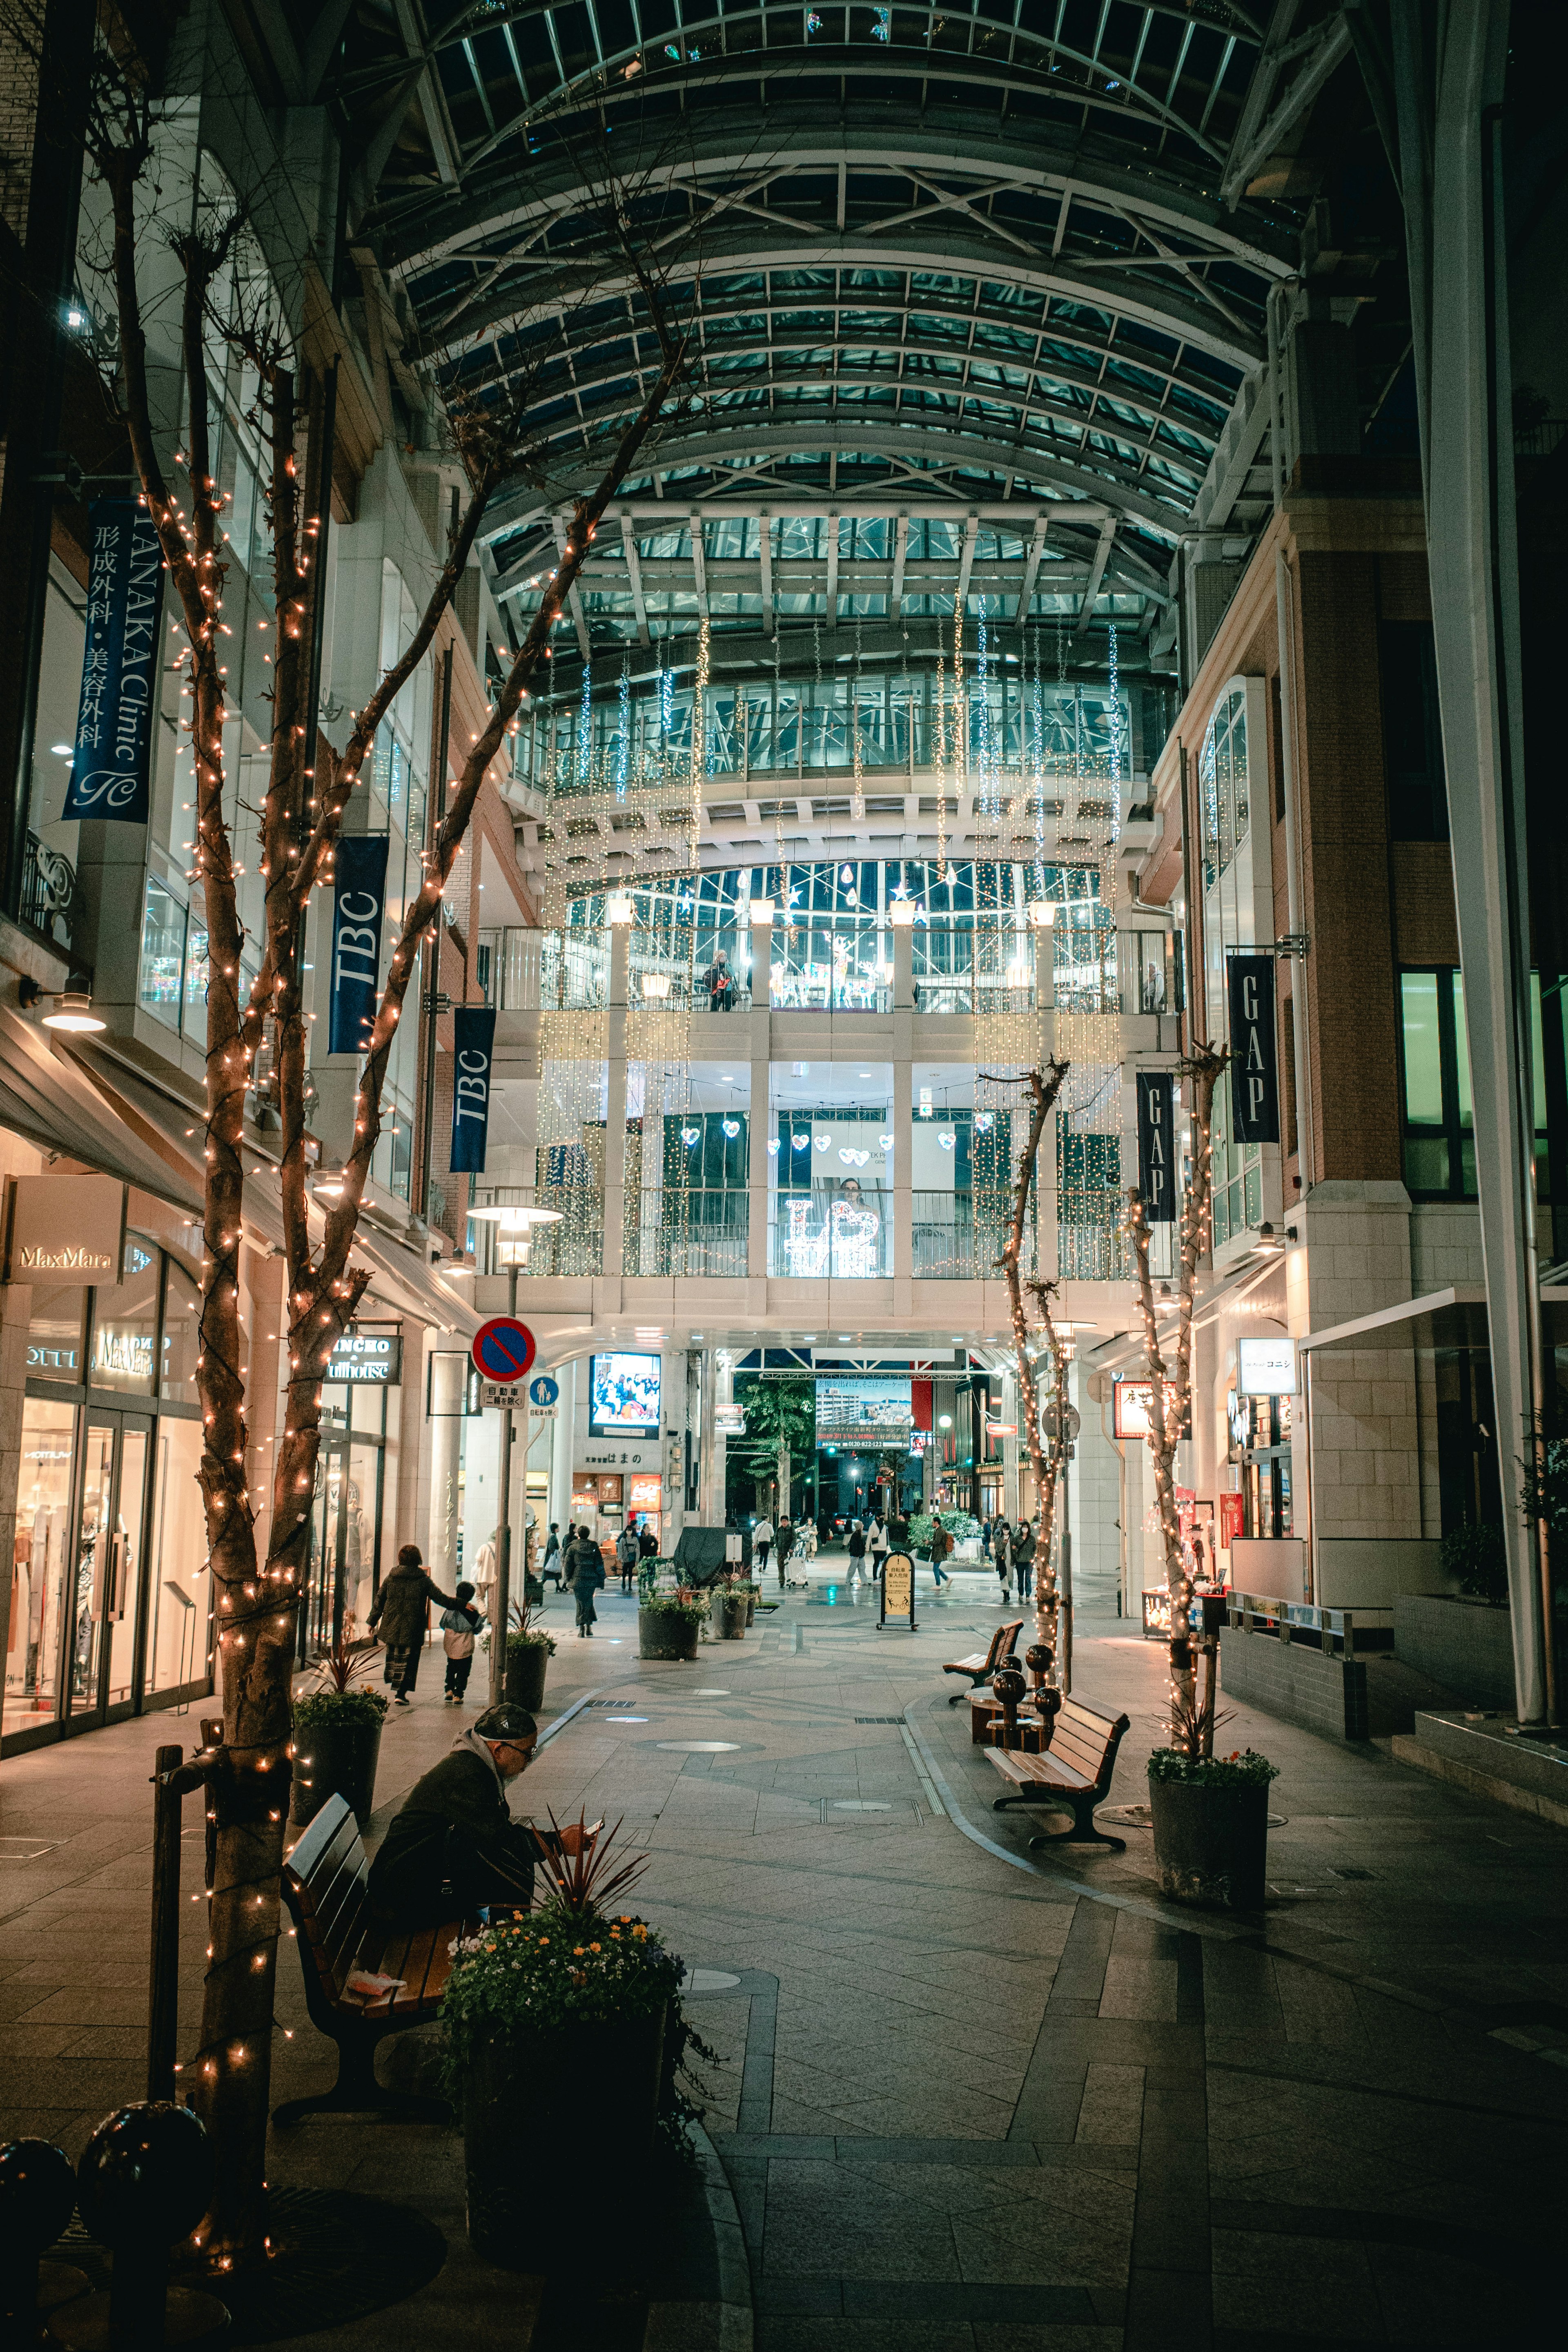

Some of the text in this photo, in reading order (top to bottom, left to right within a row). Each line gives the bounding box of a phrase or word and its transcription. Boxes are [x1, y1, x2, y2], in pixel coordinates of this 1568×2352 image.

[77, 526, 120, 749] 形成外科・美容外科
[116, 515, 159, 761] TANAKA Clinic
[336, 891, 378, 992] TBC
[456, 1050, 490, 1126] TBC
[1243, 976, 1265, 1122] GAP
[1149, 1089, 1165, 1205] GAP
[20, 1247, 111, 1268] MaxMara
[329, 1362, 388, 1379] ullhouse
[488, 1387, 519, 1396] 自動車
[608, 1453, 641, 1464] はまの
